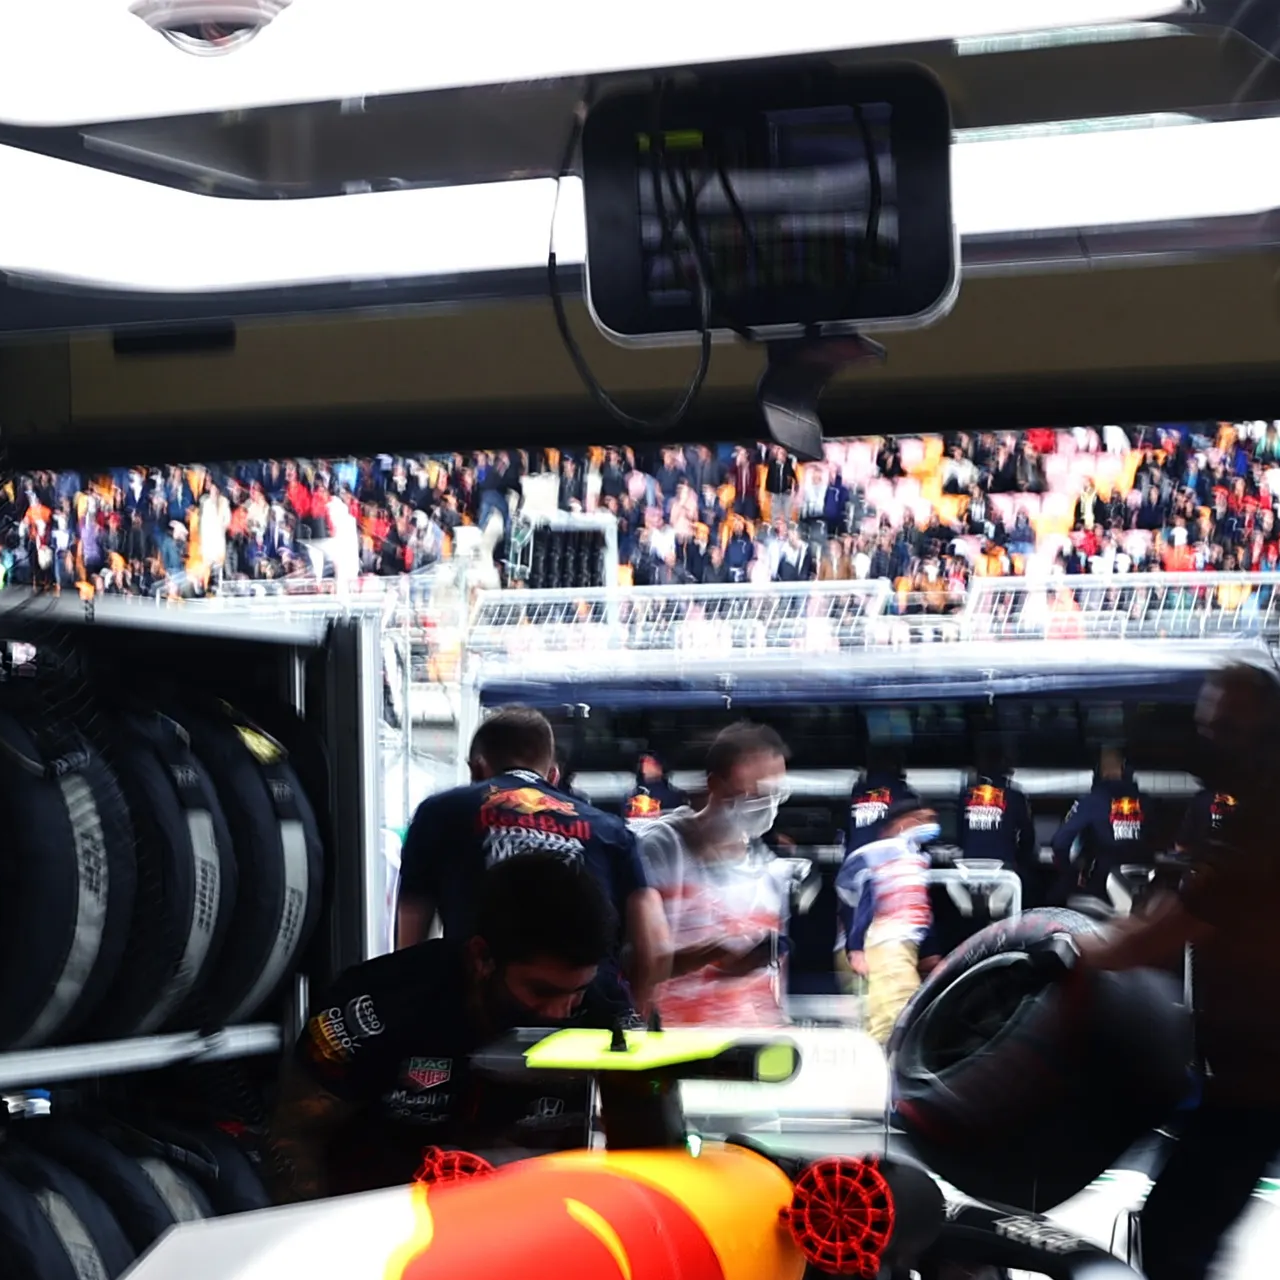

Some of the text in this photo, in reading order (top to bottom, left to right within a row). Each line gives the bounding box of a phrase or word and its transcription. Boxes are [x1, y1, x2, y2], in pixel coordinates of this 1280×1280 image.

[328, 1006, 354, 1049] Claro
[413, 1059, 448, 1070] TAG
[410, 1069, 448, 1085] HEUER
